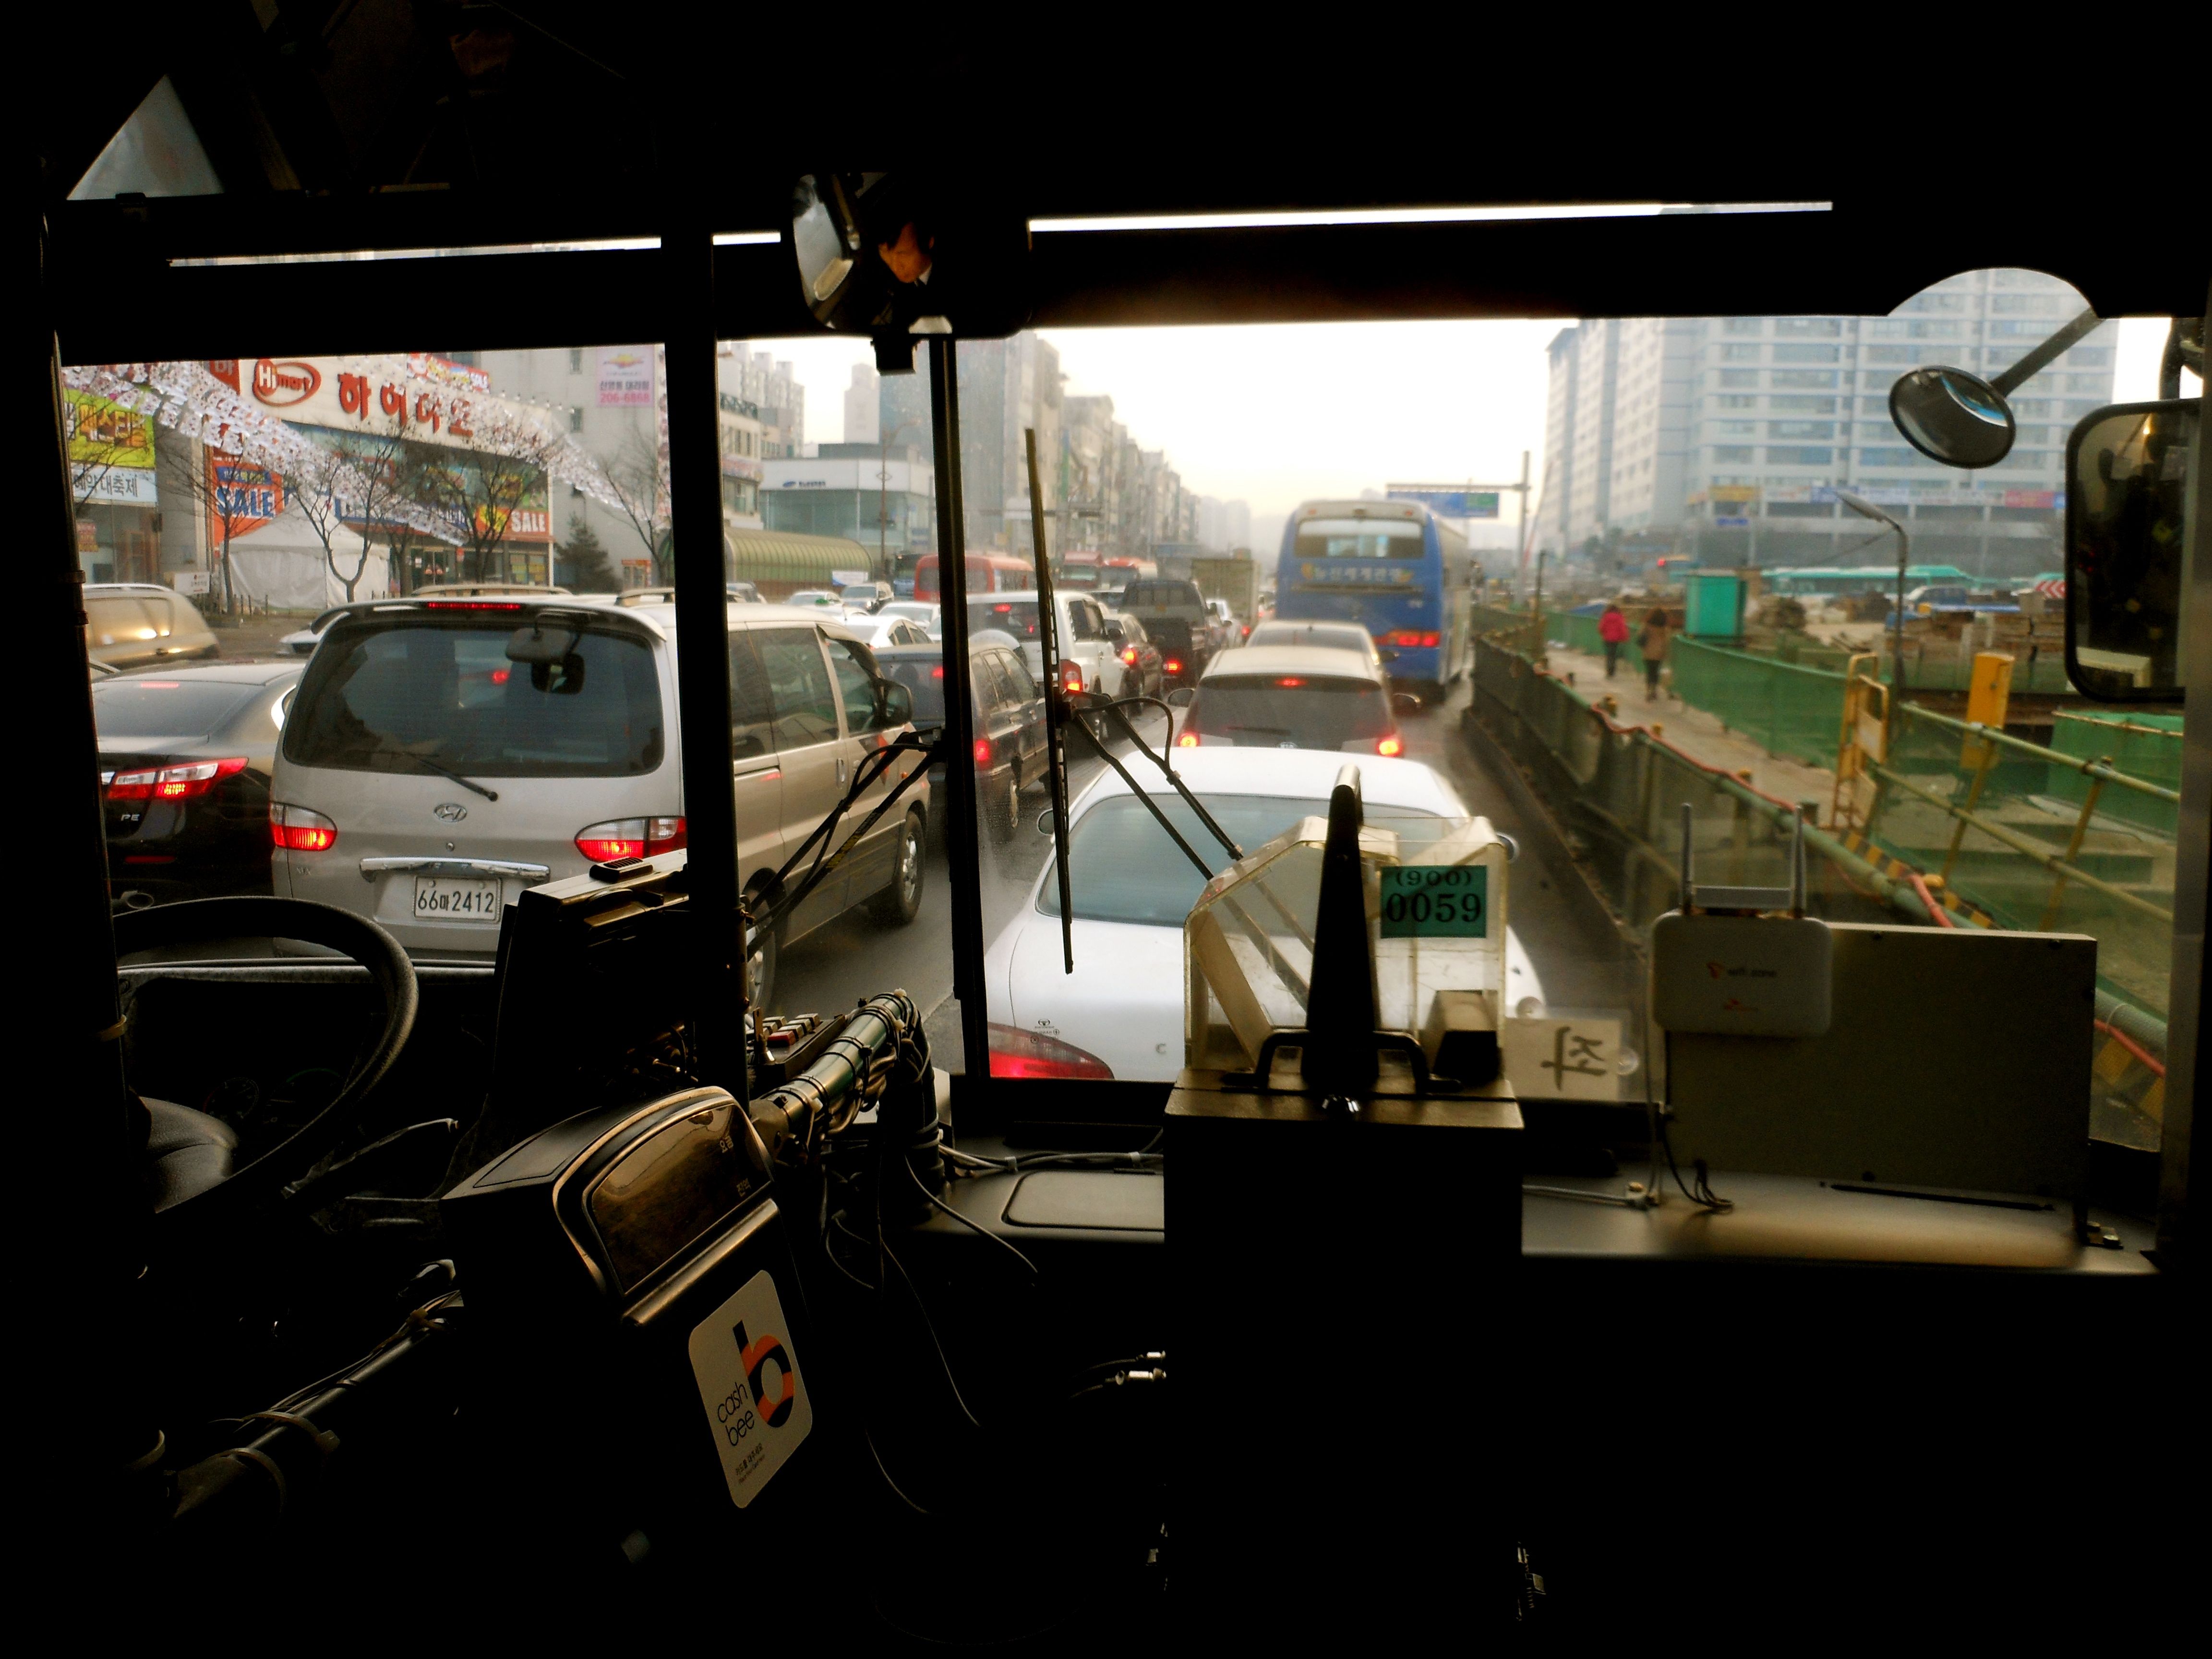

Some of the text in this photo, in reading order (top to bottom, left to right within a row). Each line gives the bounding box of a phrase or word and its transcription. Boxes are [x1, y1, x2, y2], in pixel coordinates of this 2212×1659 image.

[216, 485, 275, 518] SALE
[511, 510, 546, 532] SALE
[1396, 870, 1471, 887] (900)
[1386, 893, 1481, 923] 0059
[718, 1382, 748, 1423] cash
[725, 1410, 755, 1446] bee
